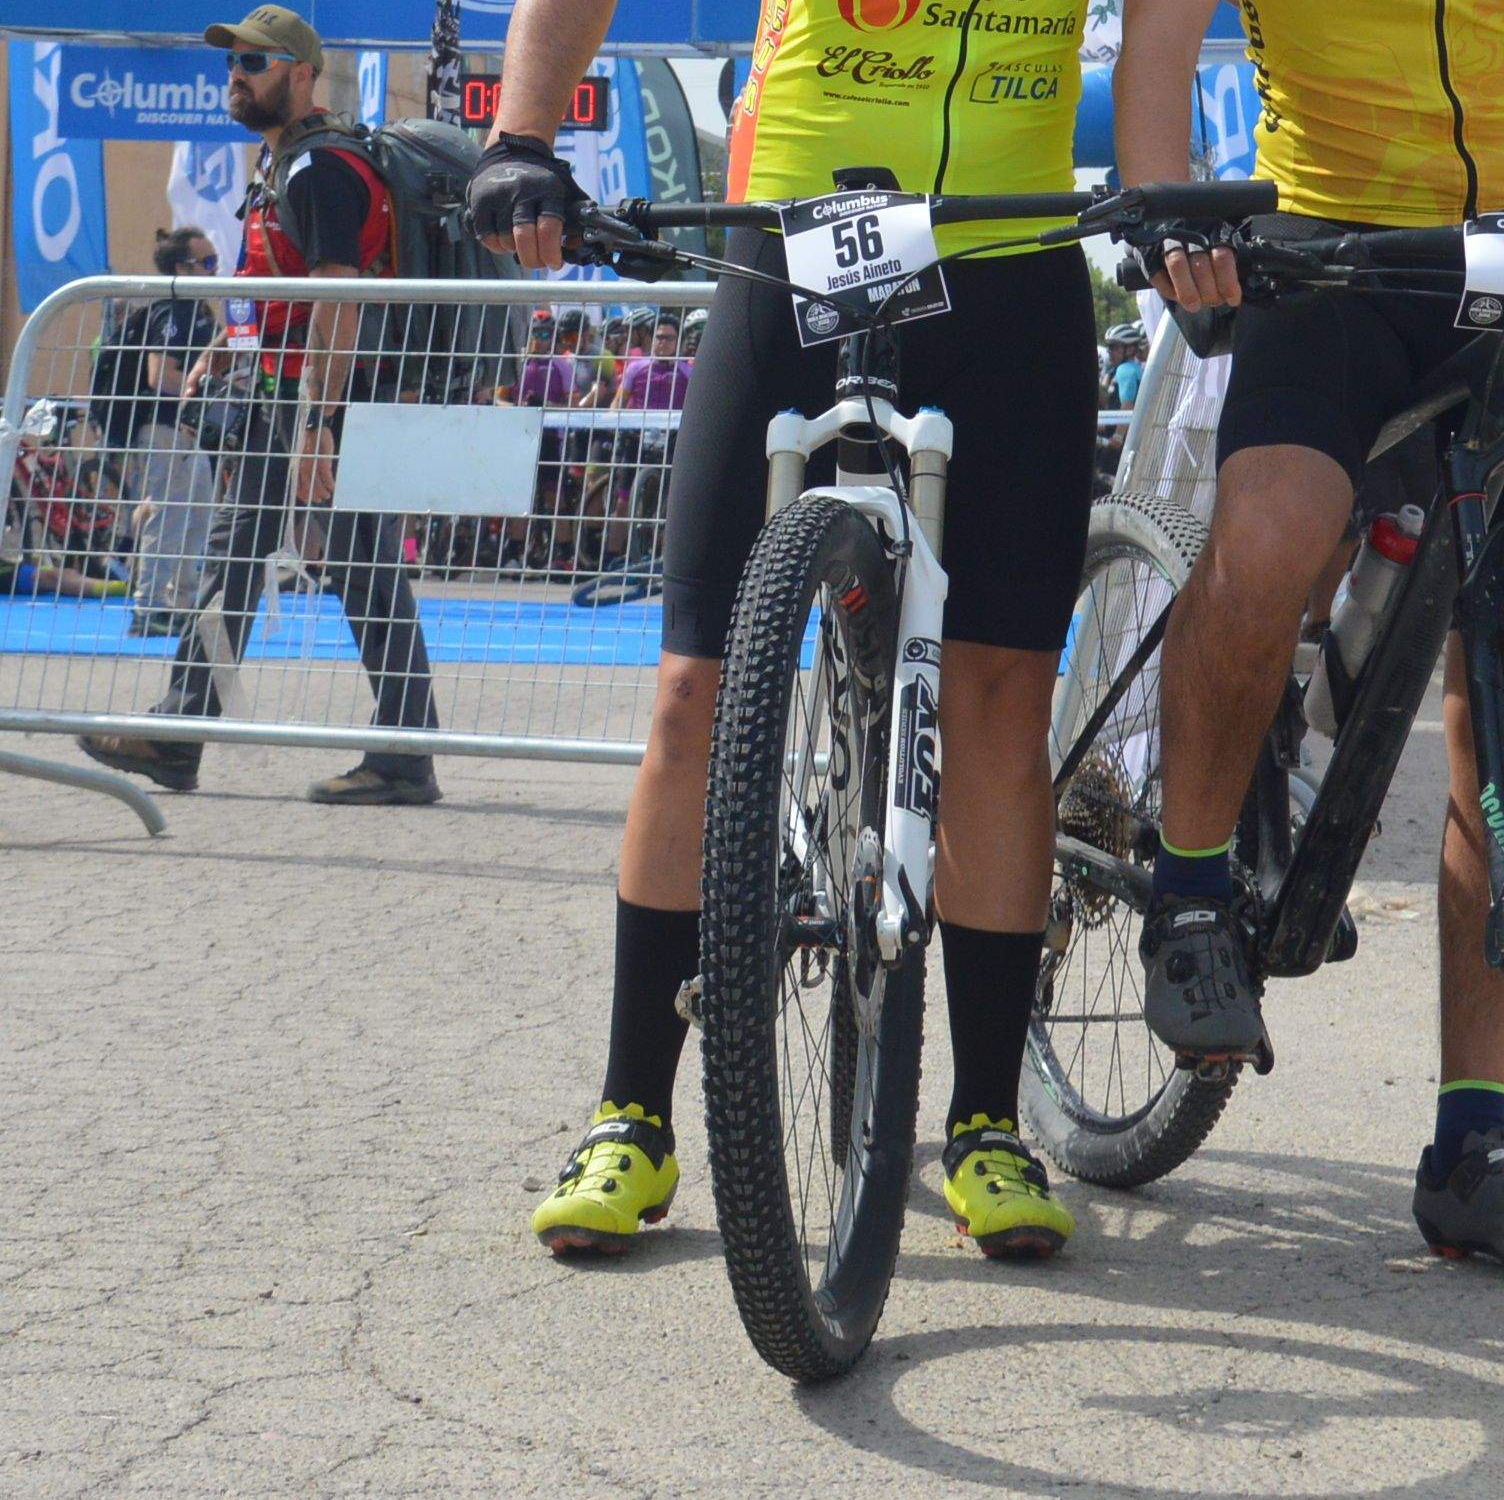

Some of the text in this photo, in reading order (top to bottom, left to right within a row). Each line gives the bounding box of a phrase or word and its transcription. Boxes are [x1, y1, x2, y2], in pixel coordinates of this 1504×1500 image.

[923, 3, 1076, 37] Santamaría
[852, 51, 935, 85] Criollo
[70, 70, 230, 114] Columbu
[990, 75, 1059, 100] TILCA
[136, 112, 203, 125] DISCOVER
[813, 194, 889, 219] Columbus
[832, 214, 884, 269] 56
[827, 259, 902, 291] Jesús Aineto
[867, 278, 921, 303] MARN
